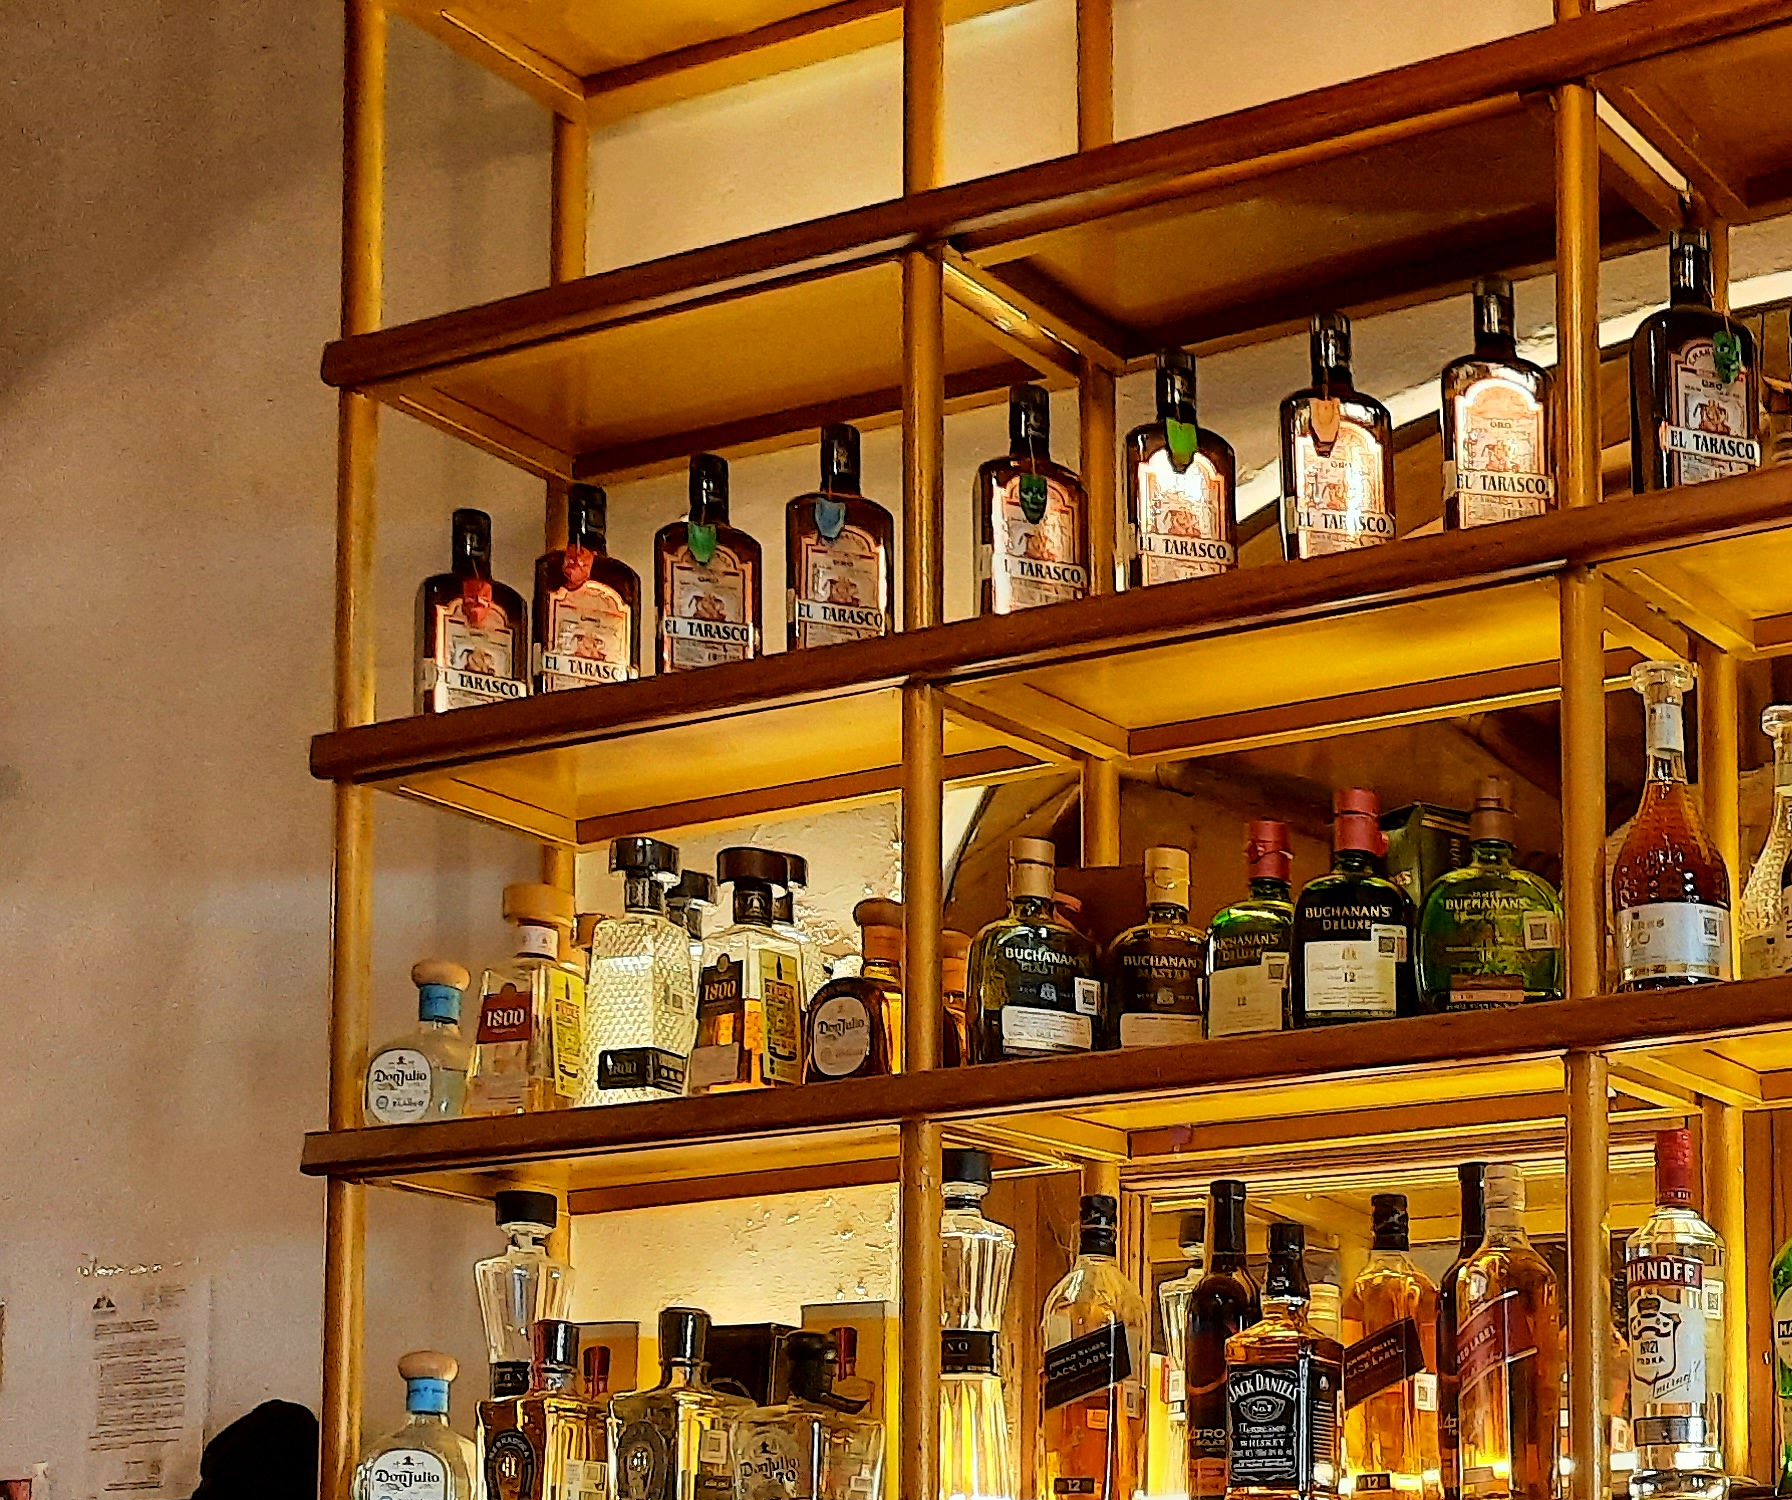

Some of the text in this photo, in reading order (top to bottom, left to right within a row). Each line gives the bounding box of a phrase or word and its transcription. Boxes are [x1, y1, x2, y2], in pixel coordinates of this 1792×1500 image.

[1670, 429, 1755, 460] EL TARASCO
[1456, 473, 1549, 496] EL TARASCO
[1163, 538, 1230, 561] TARASCO
[1018, 559, 1082, 585] TARASCO
[798, 602, 883, 628] EL TARASCO
[664, 619, 750, 643] EL TARASCO
[545, 655, 559, 671] EL
[458, 672, 520, 697] TARASCO
[1304, 904, 1393, 919] BUCHANAN'S
[1344, 971, 1356, 983] 12
[704, 980, 737, 1000] 1800
[486, 1008, 526, 1028] 1800
[1628, 1260, 1696, 1284] IRNOFF
[1469, 1325, 1497, 1350] LABEL
[1228, 1373, 1301, 1403] JACK DANIEL'S
[375, 1469, 442, 1491] Don Julio
[1066, 1480, 1081, 1491] 12
[1366, 1476, 1379, 1488] 12
